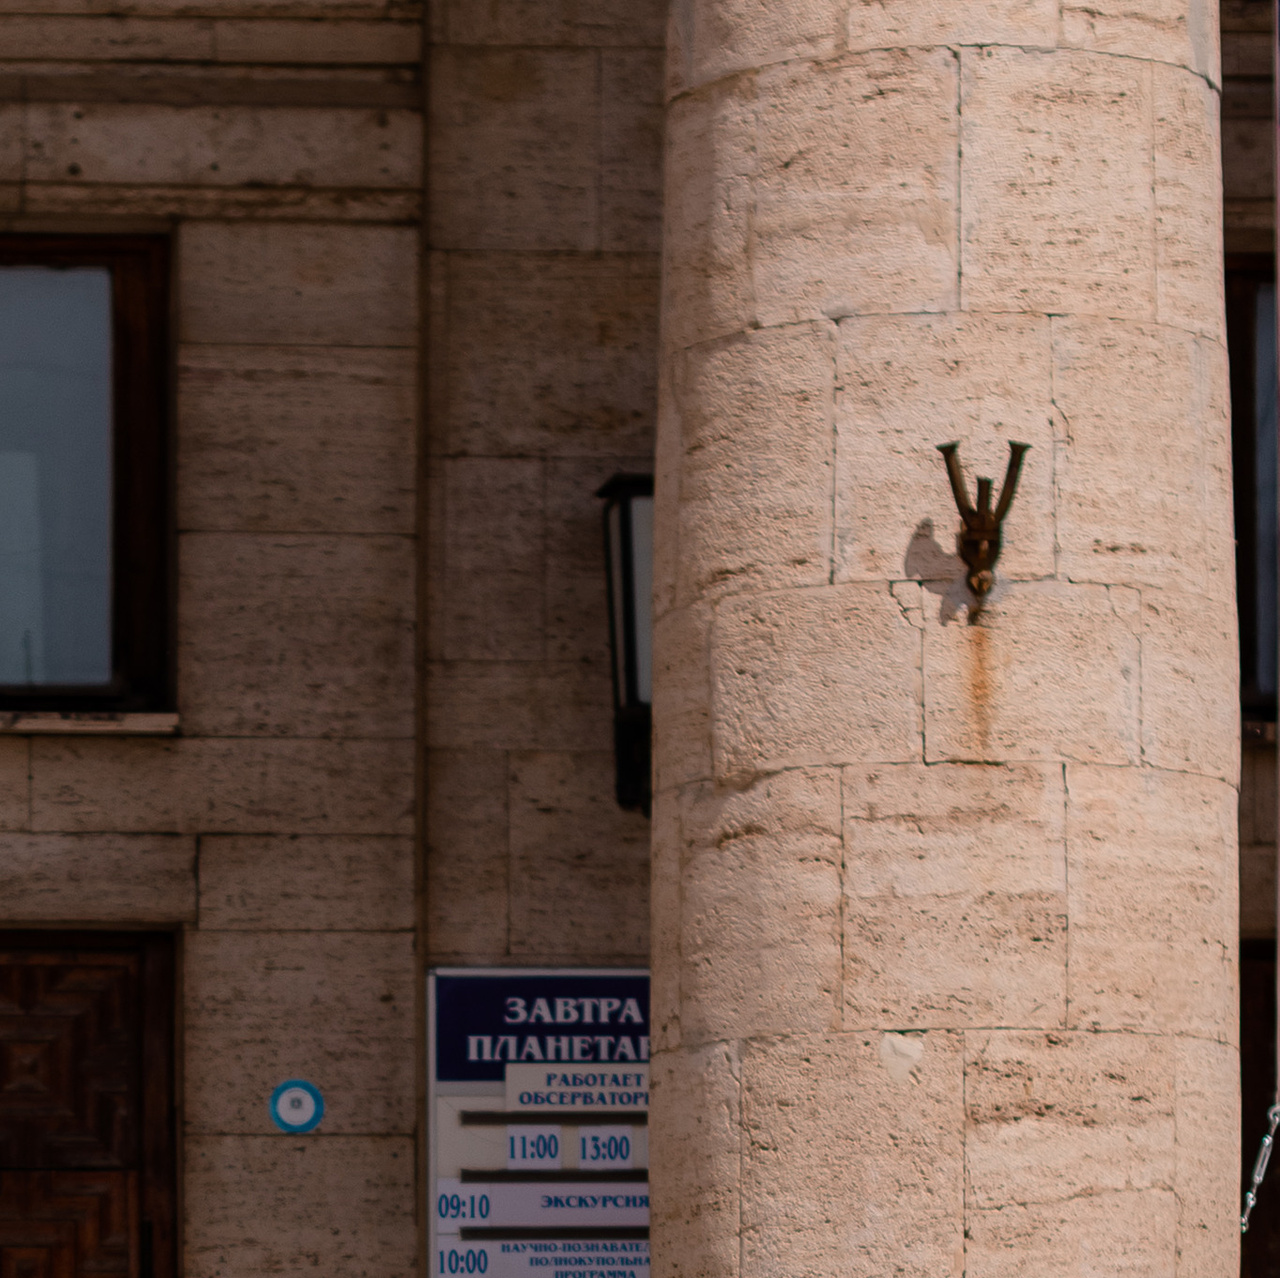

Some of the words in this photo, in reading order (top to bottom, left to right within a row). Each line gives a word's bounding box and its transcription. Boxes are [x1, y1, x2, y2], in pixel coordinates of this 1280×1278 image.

[504, 998, 644, 1024] ЗАВТРА
[546, 1073, 644, 1087] РАБОТАЕТ
[509, 1134, 560, 1160] 11:00
[580, 1136, 631, 1160] 13:00
[438, 1194, 490, 1219] 09:10
[439, 1249, 489, 1274] 10:00
